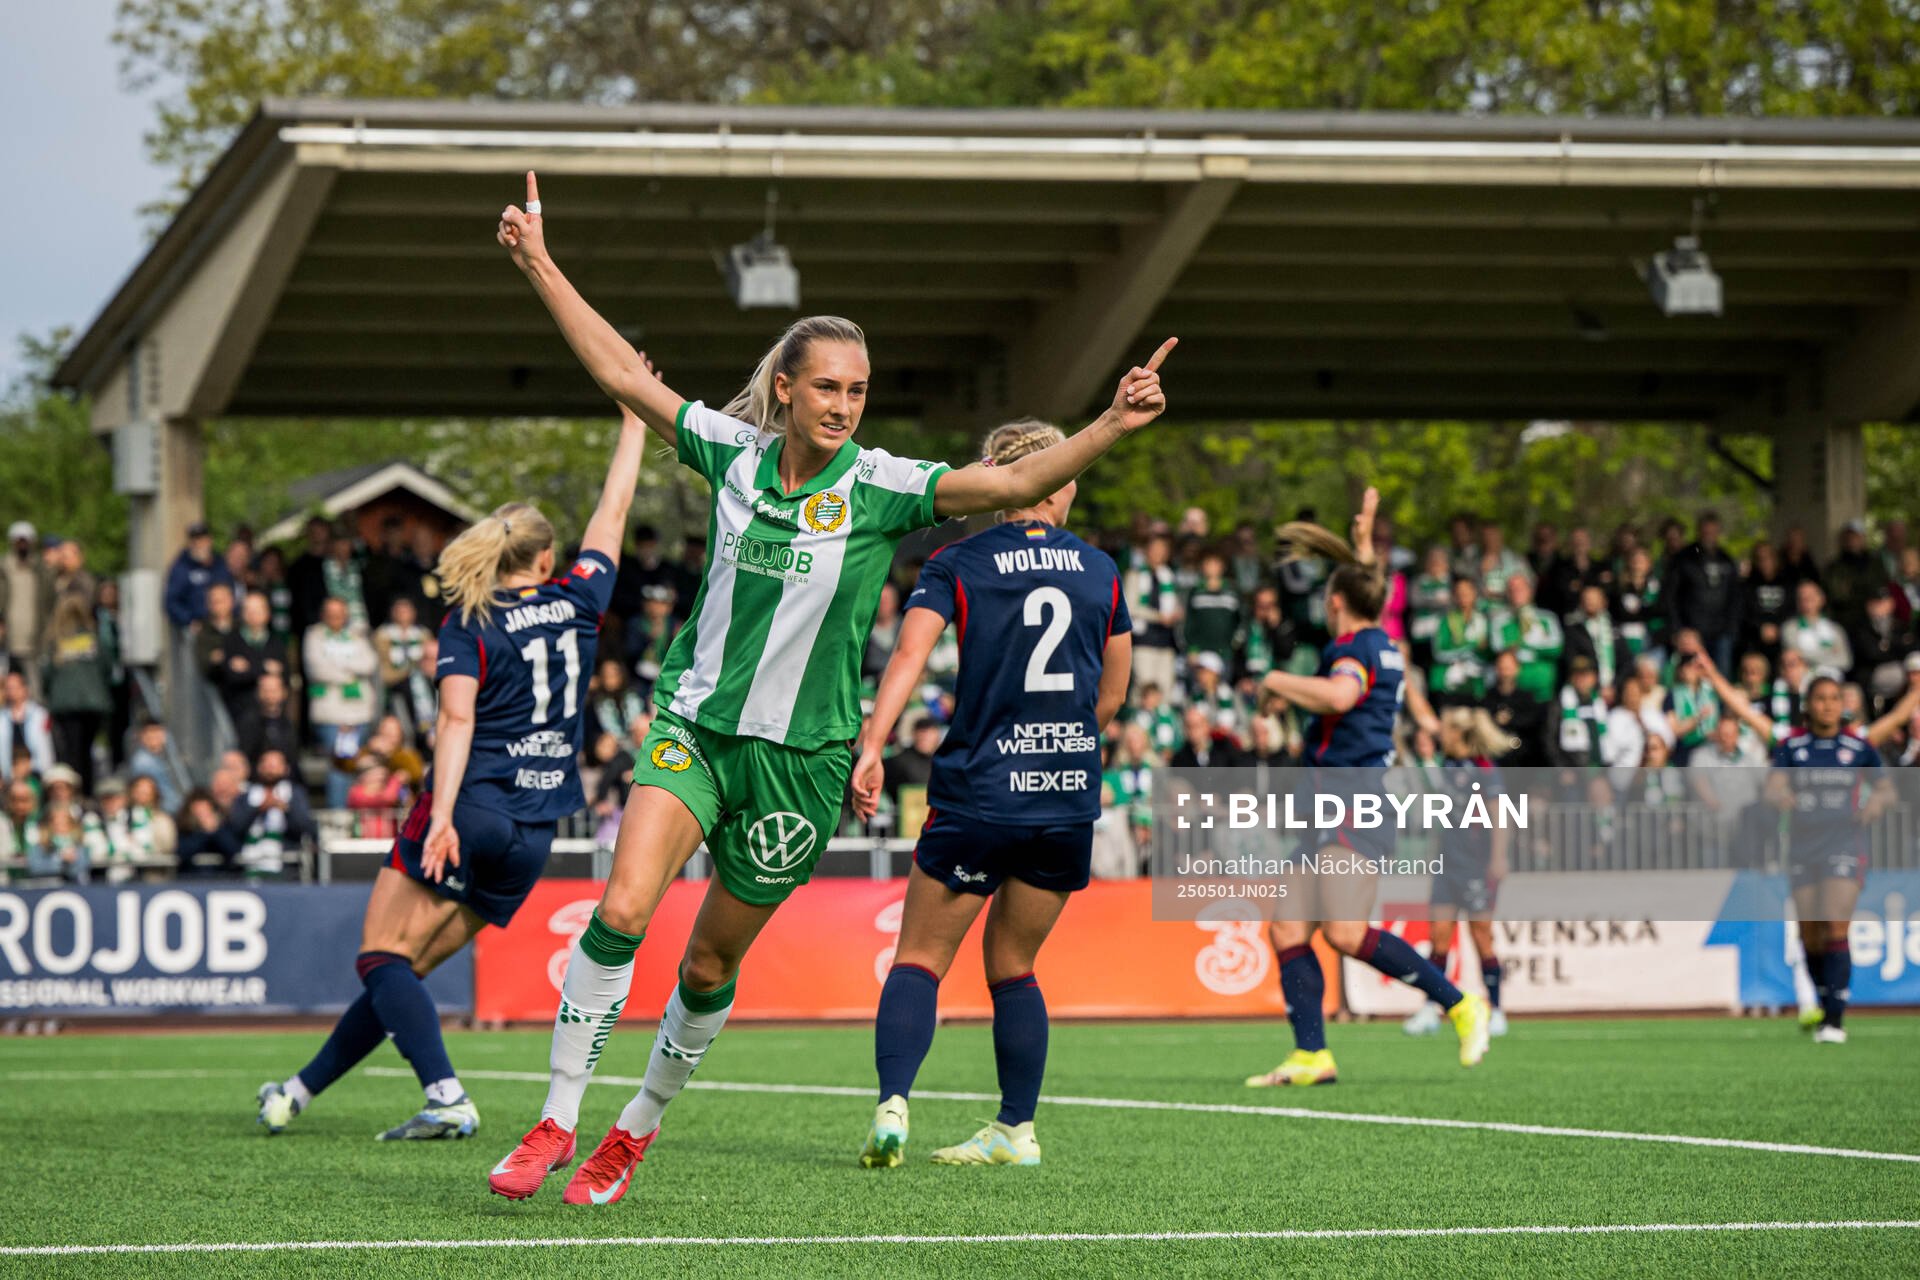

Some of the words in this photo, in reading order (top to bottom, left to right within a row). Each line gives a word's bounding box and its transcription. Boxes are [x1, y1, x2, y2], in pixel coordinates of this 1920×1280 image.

[722, 532, 813, 574] PROJOB
[993, 548, 1085, 575] WOLDVIK
[1023, 586, 1075, 693] 2
[521, 628, 580, 725] 11
[997, 737, 1096, 755] WELLNESS
[1013, 721, 1084, 739] NORDIC
[1501, 914, 1660, 946] VENSKA
[1502, 955, 1573, 987] PEL
